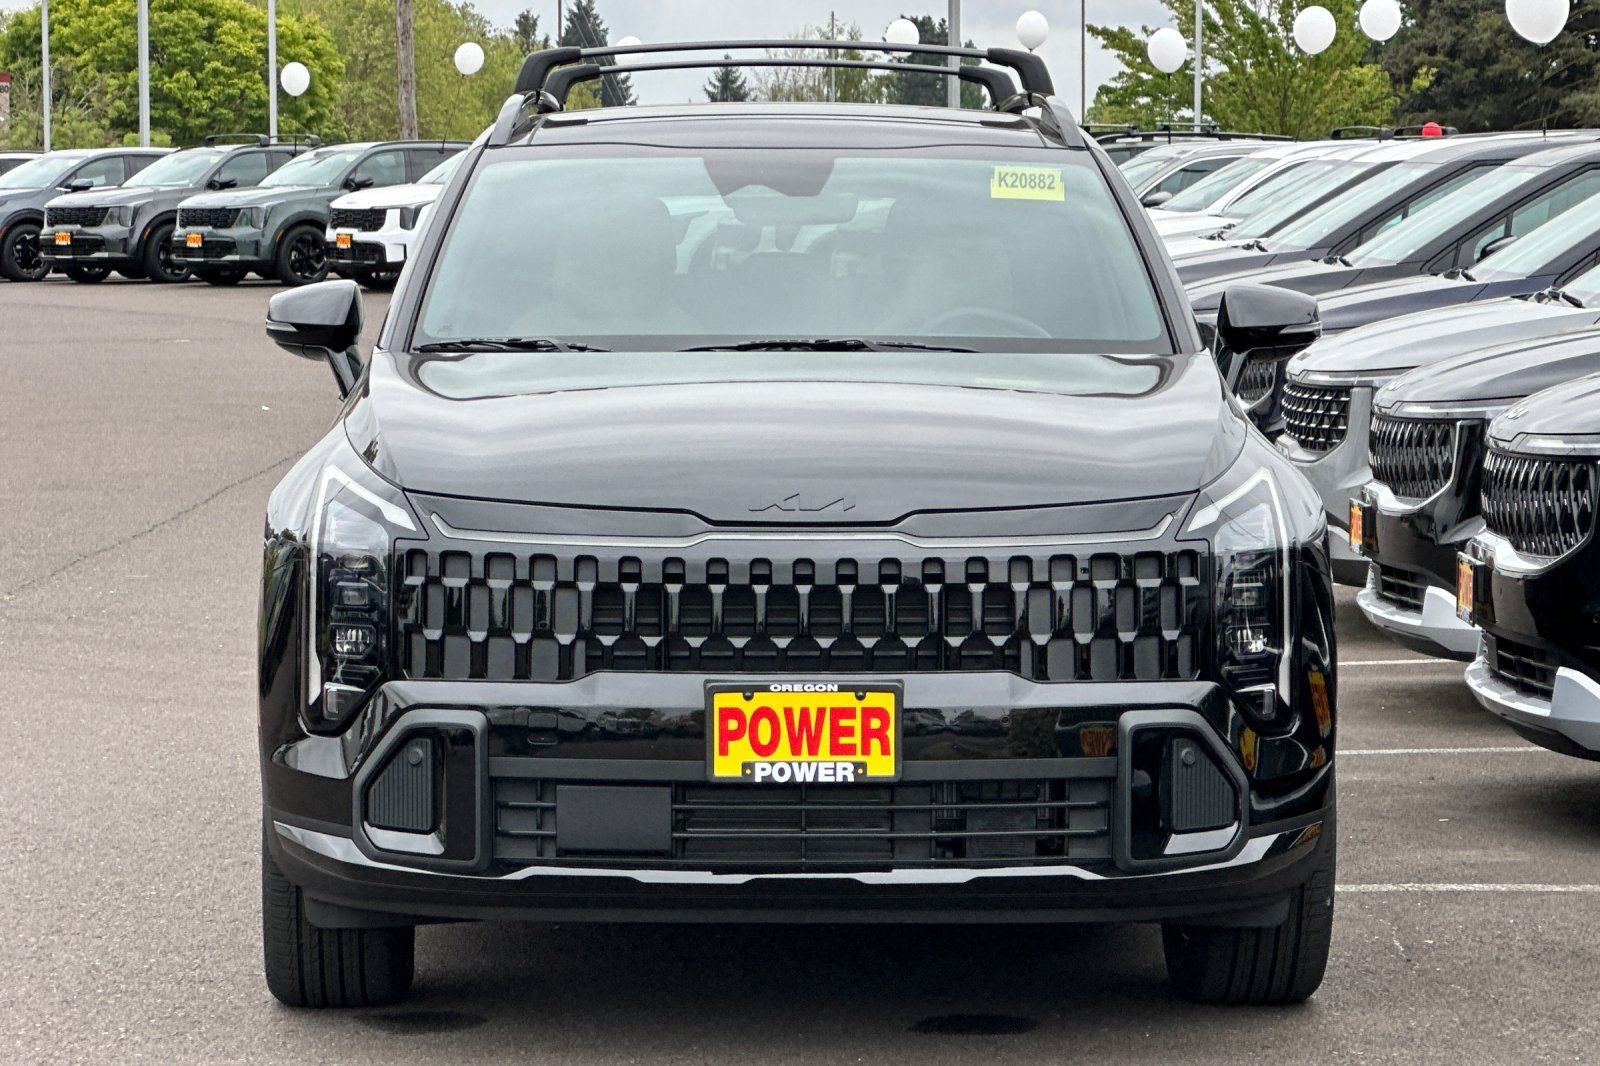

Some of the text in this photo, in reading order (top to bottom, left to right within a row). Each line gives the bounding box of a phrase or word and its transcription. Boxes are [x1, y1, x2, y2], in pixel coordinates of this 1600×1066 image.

[998, 172, 1056, 190] K20882
[769, 684, 839, 692] OREGON
[718, 706, 891, 757] POWER
[754, 762, 855, 782] POWER
